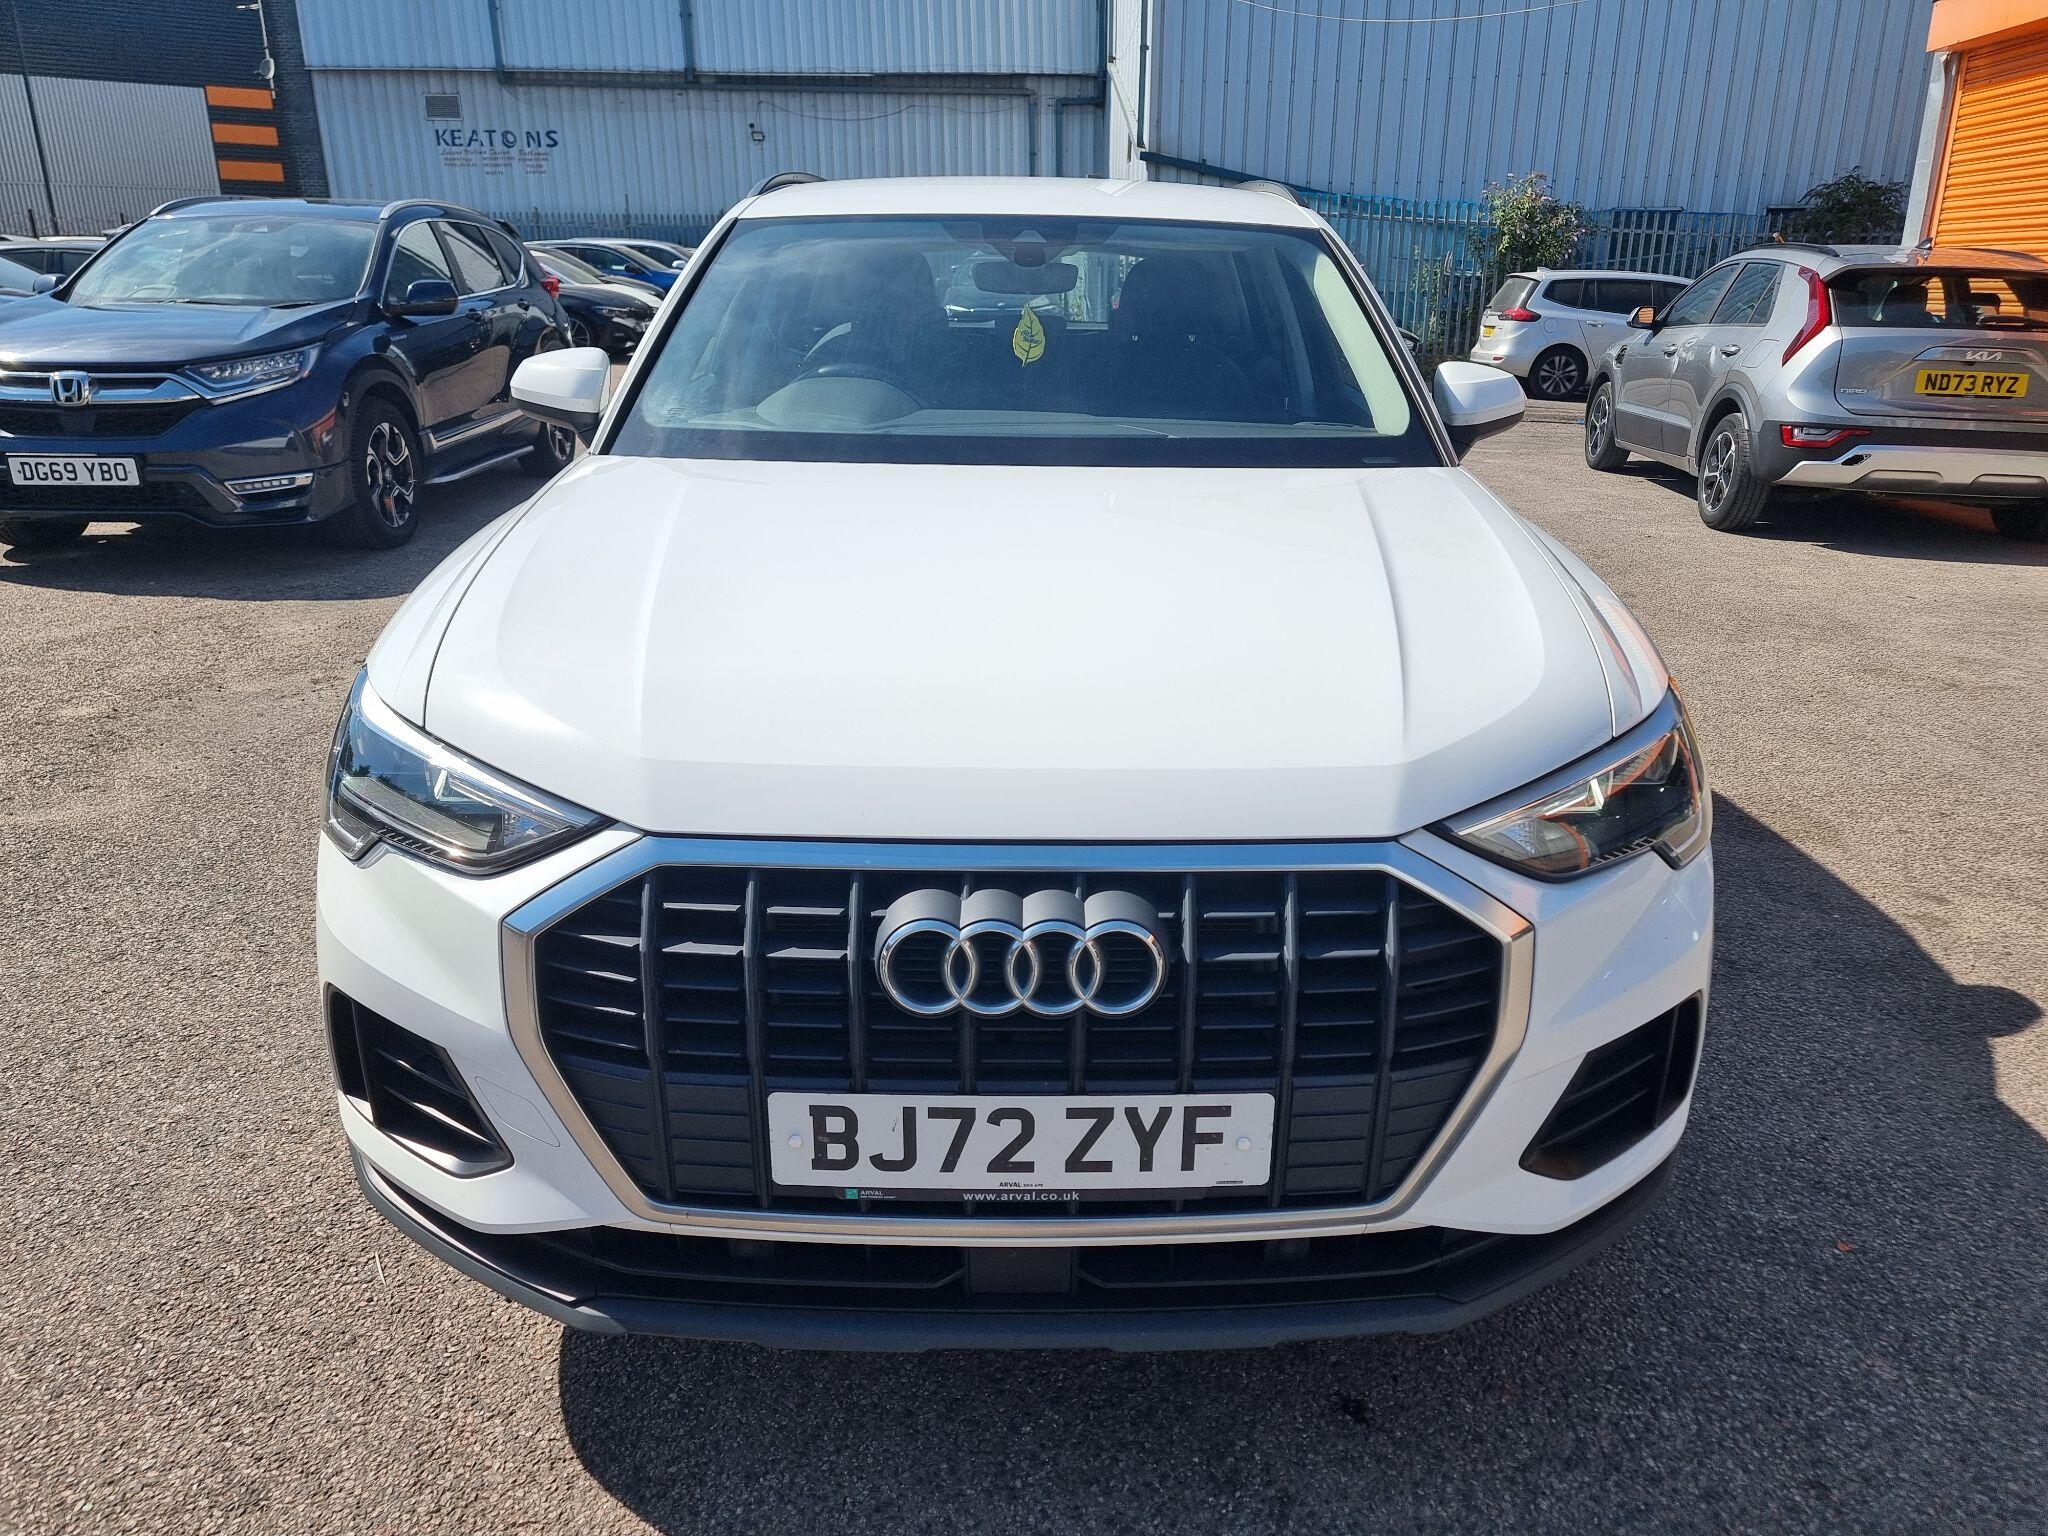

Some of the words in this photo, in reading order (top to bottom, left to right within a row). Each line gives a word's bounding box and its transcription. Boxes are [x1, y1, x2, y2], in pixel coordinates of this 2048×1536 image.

[435, 129, 559, 149] KEATONS
[1924, 373, 1978, 391] ND73
[1981, 375, 2021, 394] RYZ
[20, 461, 78, 481] DG69
[83, 462, 128, 481] YBO
[808, 1104, 1036, 1173] BJ72
[1064, 1105, 1232, 1173] ZYF
[963, 1191, 1079, 1201] www.arval.co.uk
